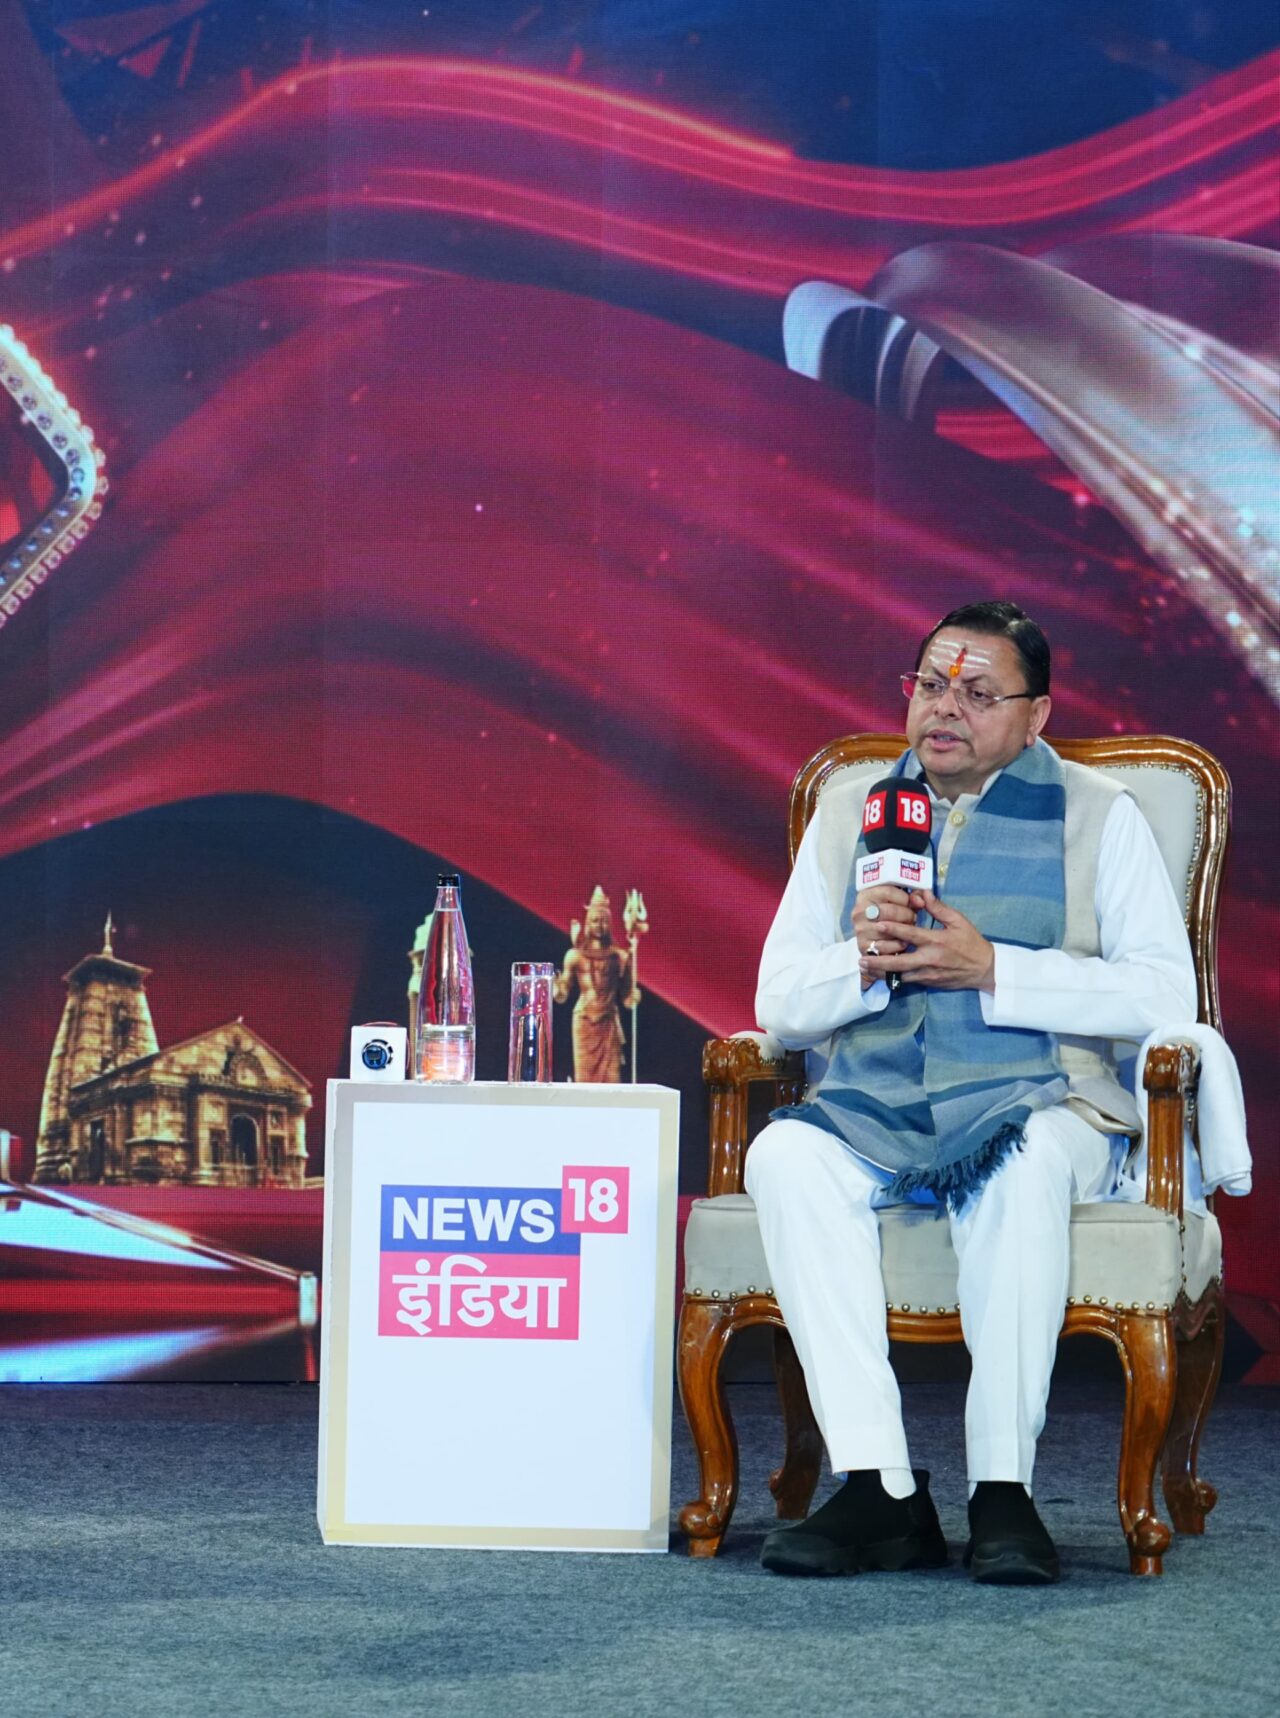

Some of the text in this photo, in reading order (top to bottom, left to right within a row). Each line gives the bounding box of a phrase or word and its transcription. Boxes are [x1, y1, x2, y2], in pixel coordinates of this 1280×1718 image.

[864, 799, 881, 826] 18
[901, 798, 926, 824] 18
[392, 1178, 619, 1244] NEWS 18
[392, 1254, 567, 1336] इंडिया
